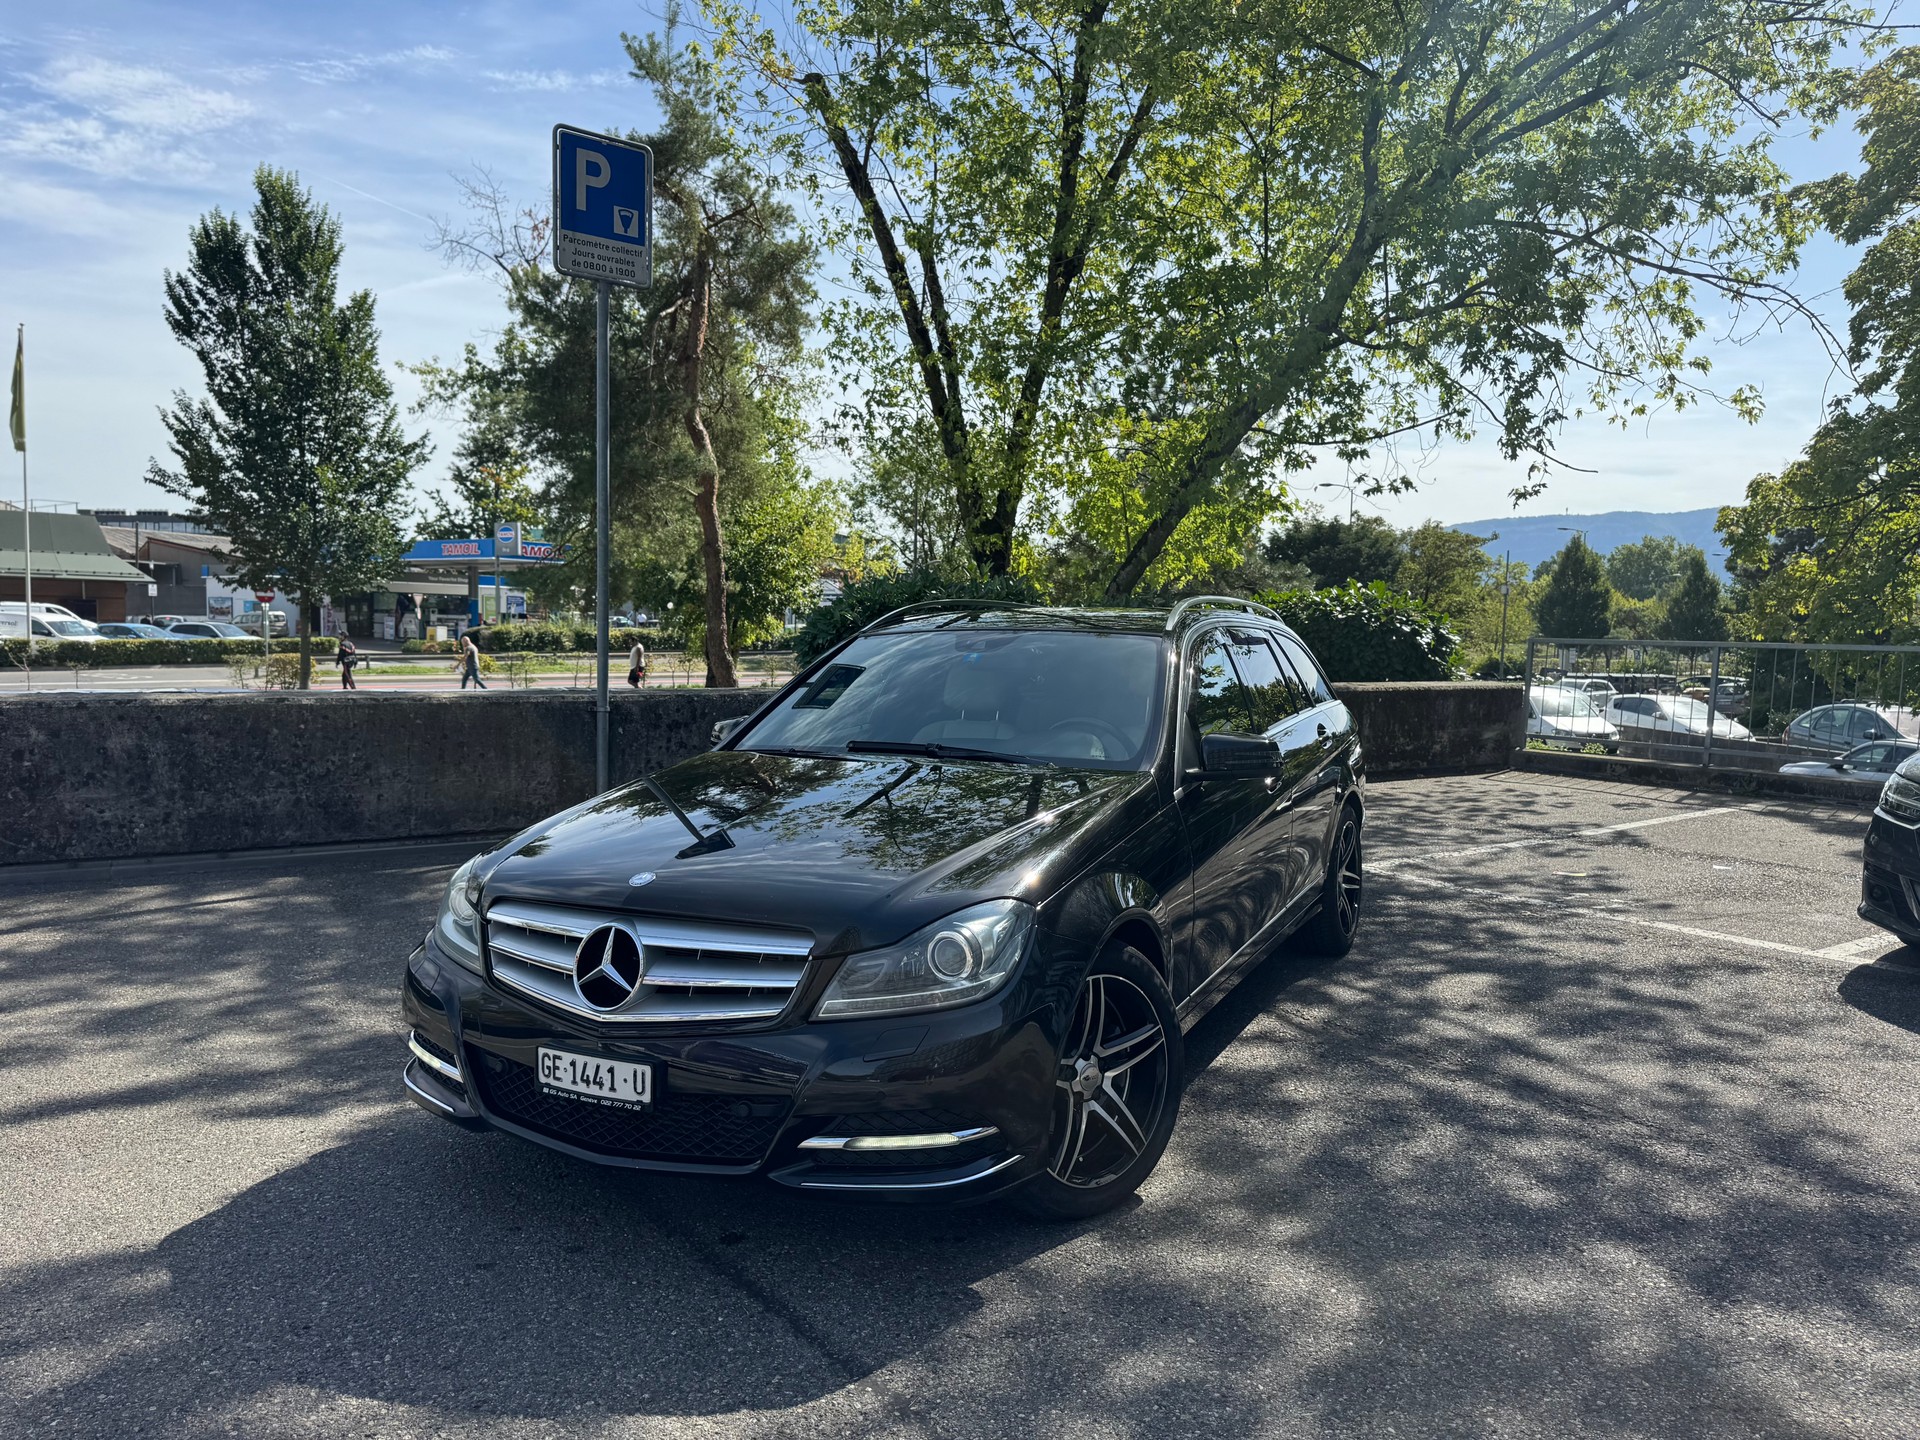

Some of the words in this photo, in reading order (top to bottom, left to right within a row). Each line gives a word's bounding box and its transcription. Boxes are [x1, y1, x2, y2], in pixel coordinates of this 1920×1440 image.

[576, 148, 611, 211] P
[563, 234, 610, 250] Parcomètre
[611, 246, 643, 258] collectif
[572, 248, 595, 259] Jours
[597, 254, 635, 267] ouvrables
[571, 260, 581, 268] de
[608, 266, 614, 274] à
[441, 543, 480, 556] TAMOIL
[558, 1089, 569, 1098] Auto
